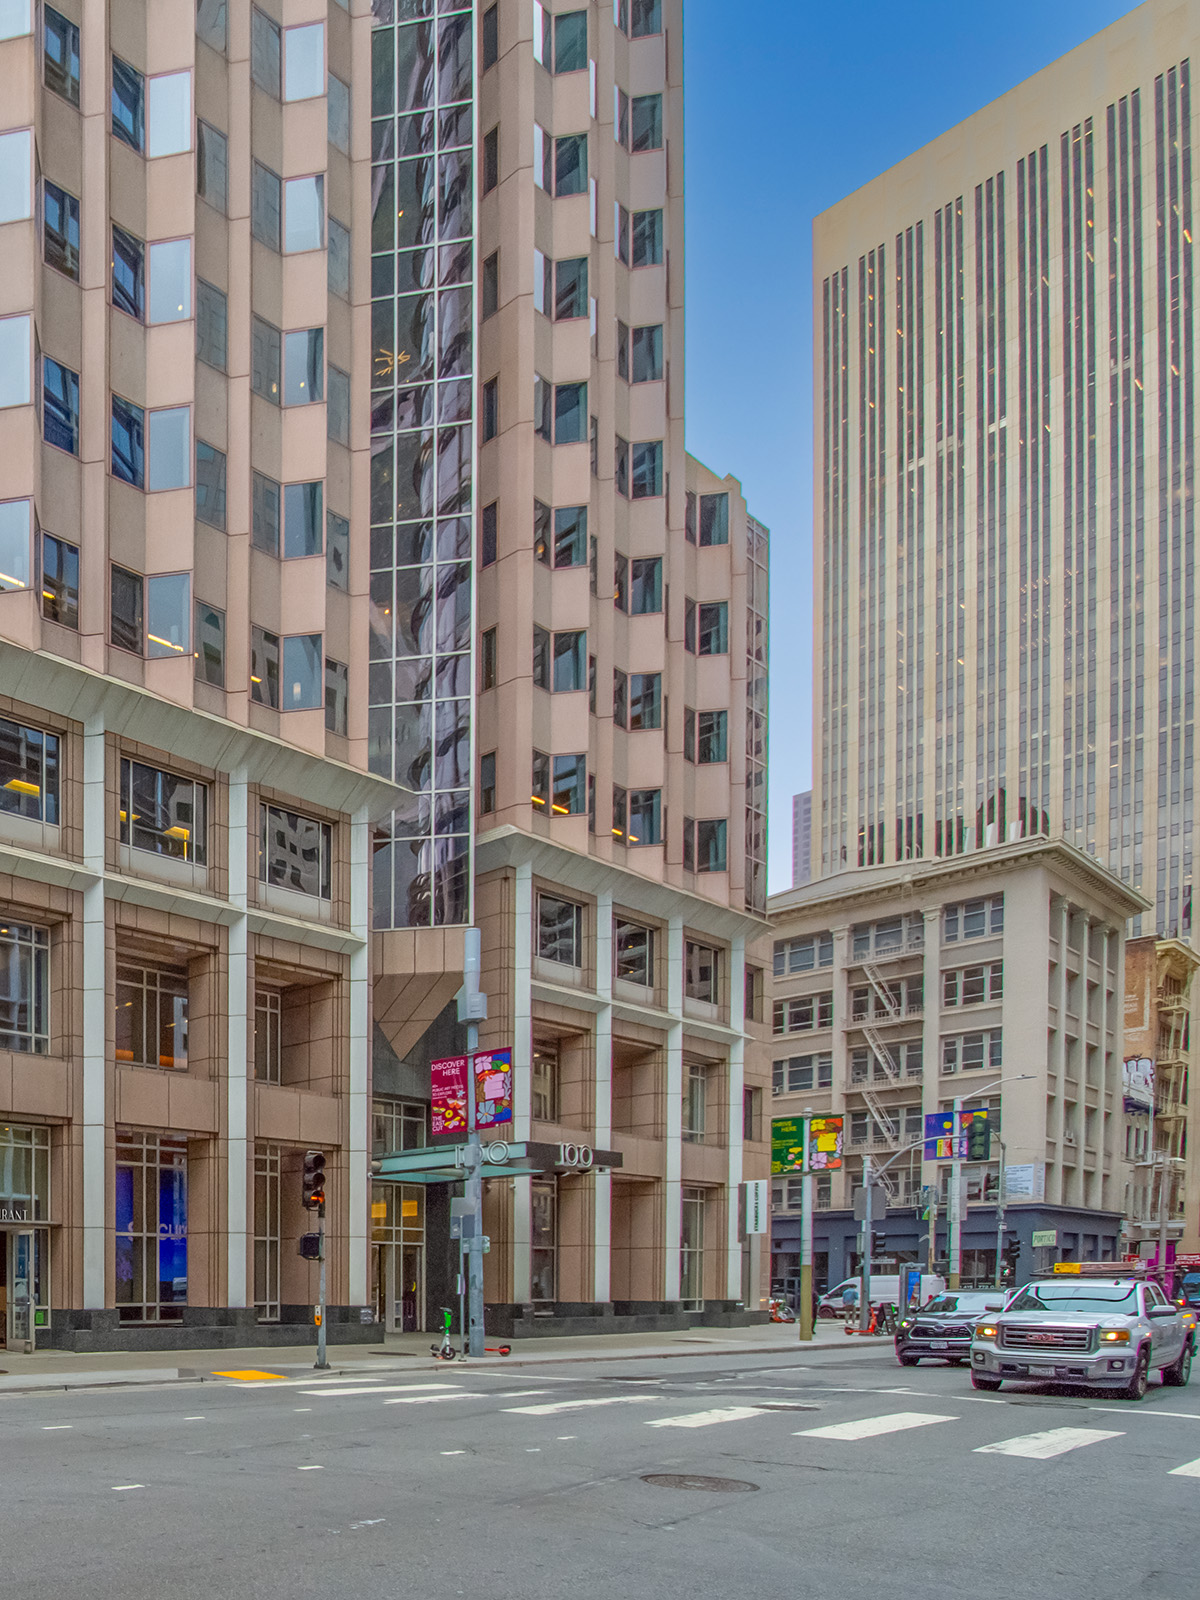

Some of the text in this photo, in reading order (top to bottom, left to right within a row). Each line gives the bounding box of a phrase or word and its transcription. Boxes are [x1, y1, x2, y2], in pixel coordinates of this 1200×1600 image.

[431, 1060, 465, 1071] DISCOVER
[442, 1068, 460, 1076] HERE
[432, 1119, 446, 1127] EAST
[555, 1141, 593, 1168] 100
